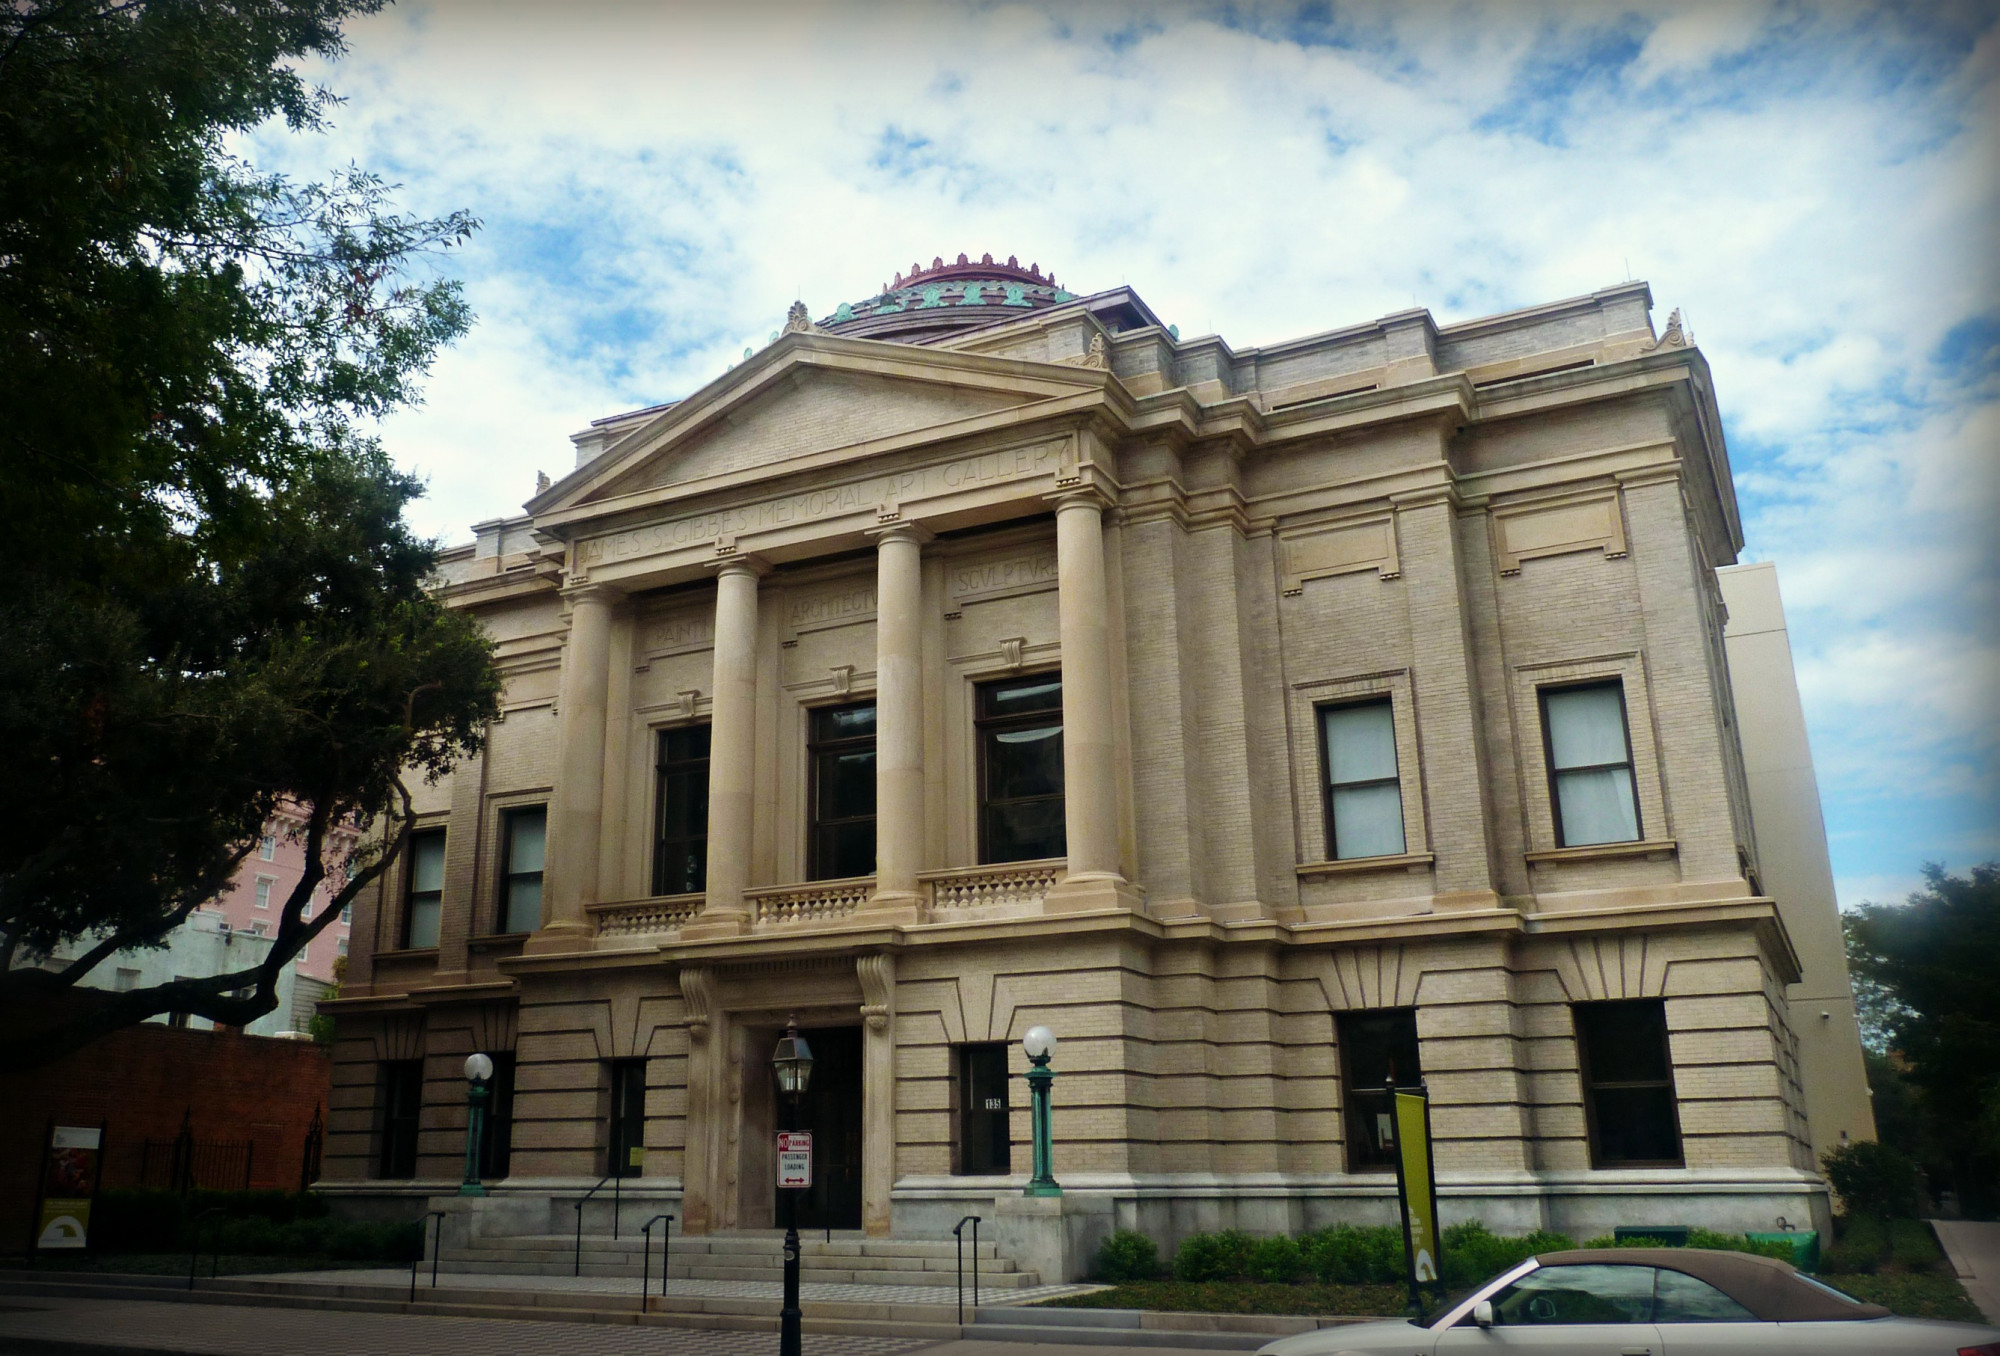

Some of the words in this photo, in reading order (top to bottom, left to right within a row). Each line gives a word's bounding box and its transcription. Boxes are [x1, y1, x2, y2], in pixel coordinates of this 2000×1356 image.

[580, 532, 641, 563] JAMES
[653, 527, 663, 548] S
[673, 509, 747, 542] GIBBES
[758, 484, 872, 525] MEMORIAL
[885, 469, 928, 501] ART
[943, 440, 1069, 488] GALLERY
[791, 588, 878, 622] ARCHITECTV
[985, 1098, 1001, 1109] 135
[779, 1138, 788, 1148] NO
